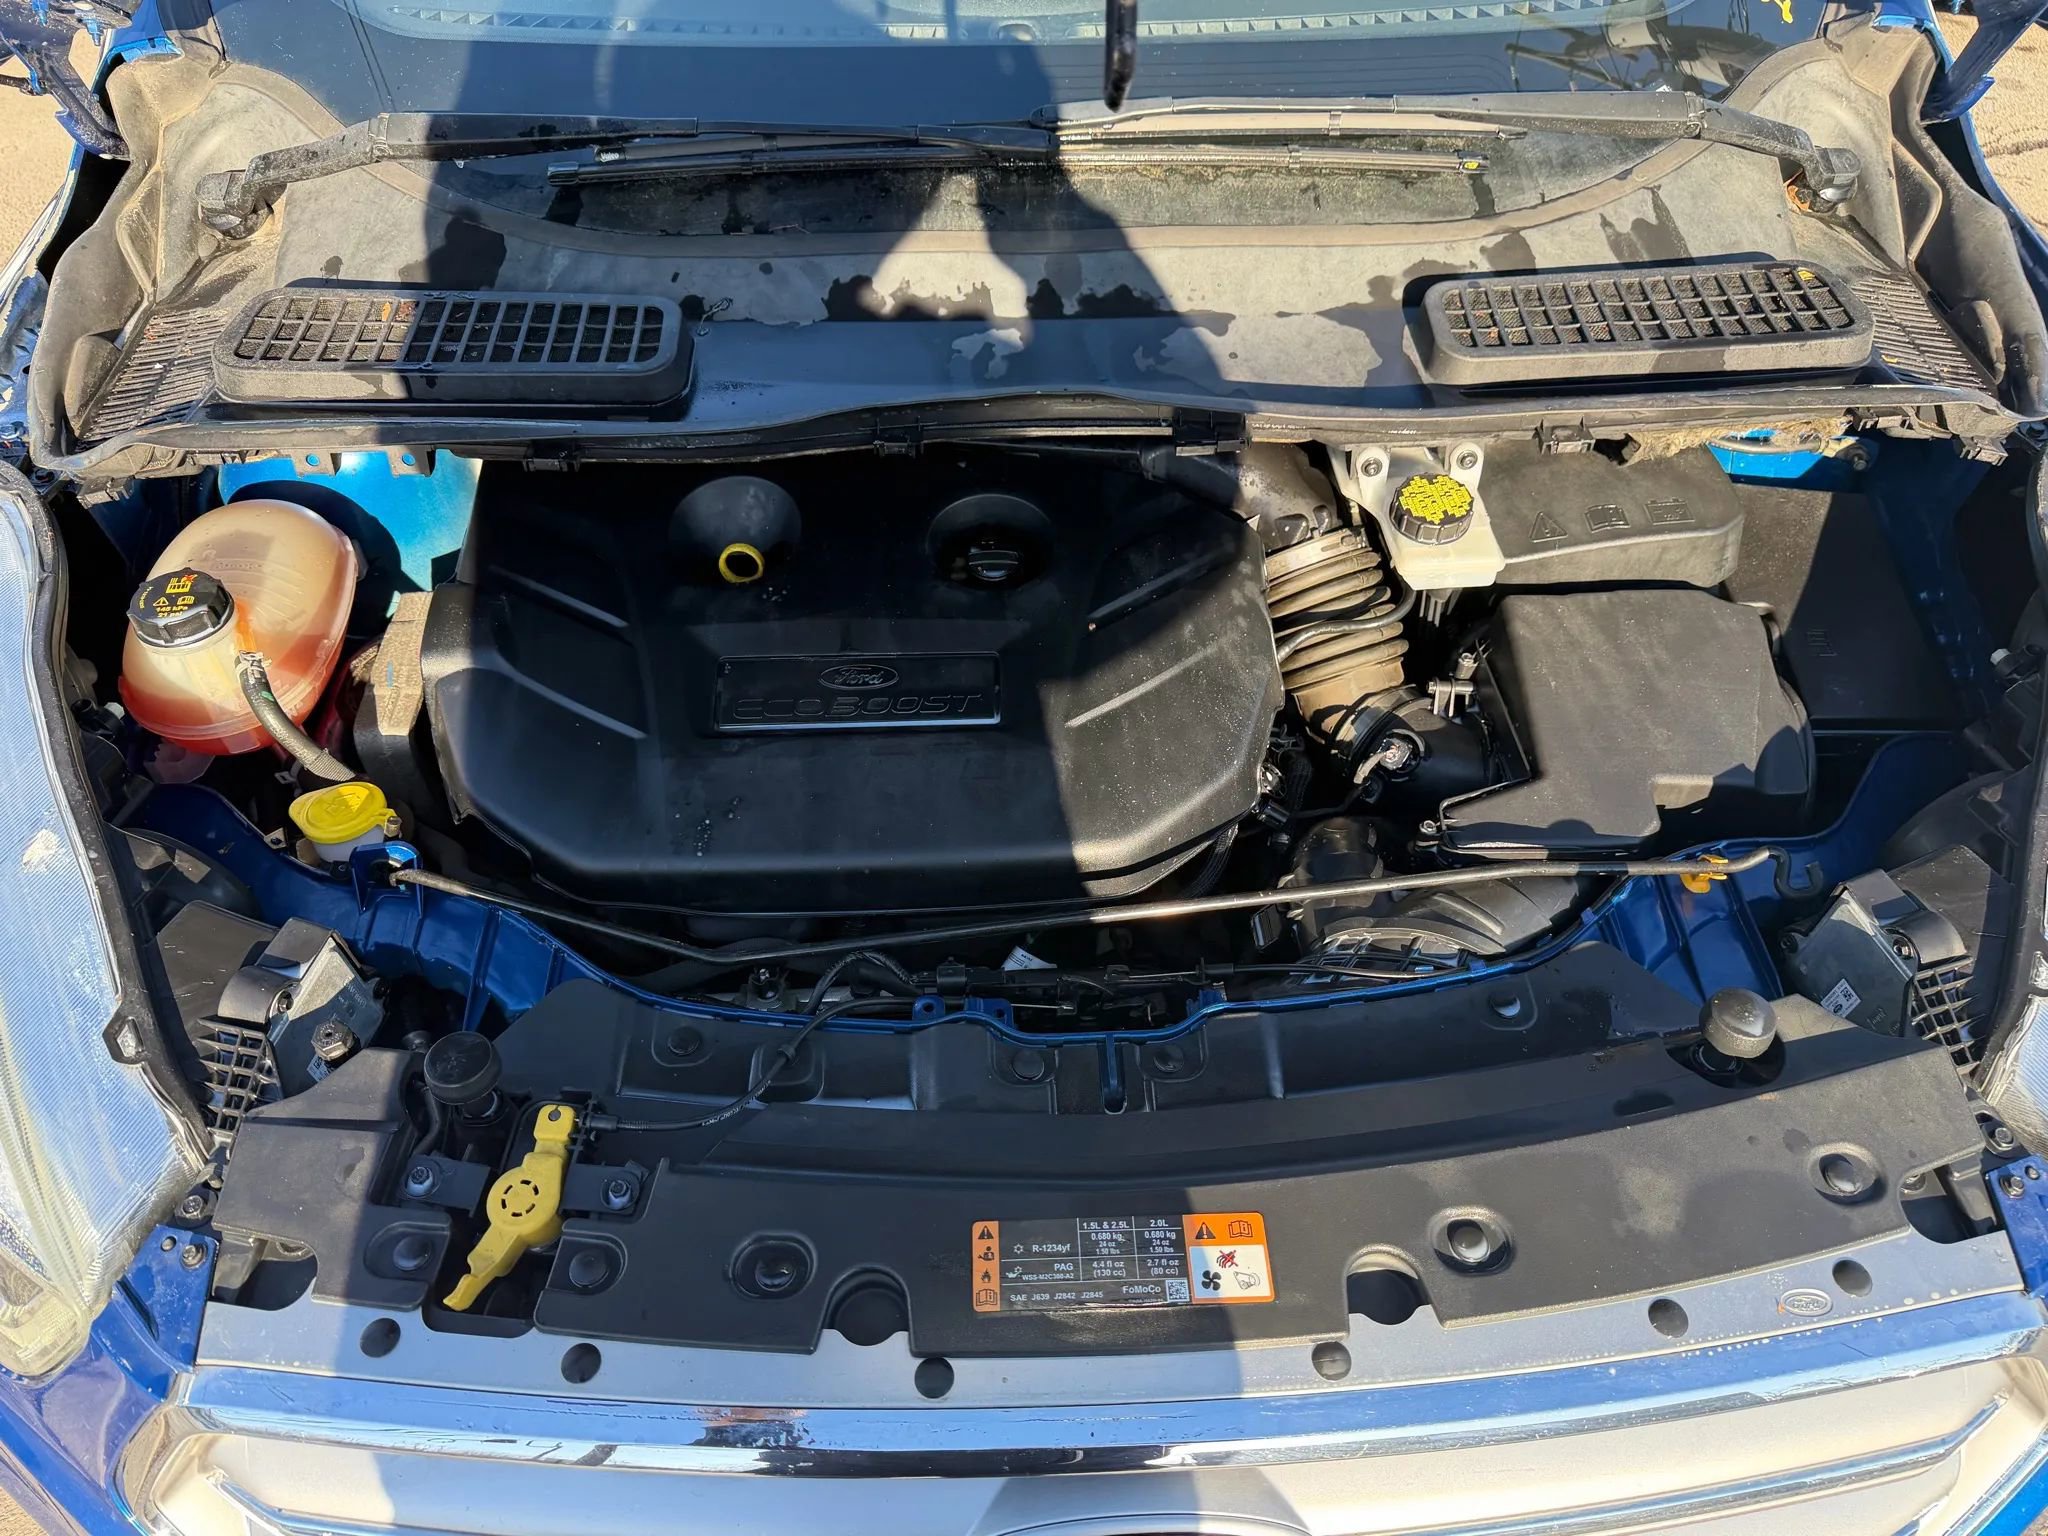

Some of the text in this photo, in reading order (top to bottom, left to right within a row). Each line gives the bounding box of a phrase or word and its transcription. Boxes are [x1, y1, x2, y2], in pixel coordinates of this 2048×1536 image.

[733, 694, 982, 720] ECOBOOST
[1082, 1220, 1130, 1230] 1.5L & 2.5L
[1150, 1219, 1169, 1227] 2.0L
[1091, 1232, 1123, 1241] 0.680 kg
[1144, 1230, 1176, 1239] 0.680 kg
[1032, 1243, 1071, 1253] R-1234yf
[1054, 1262, 1074, 1271] PAG
[1161, 1258, 1167, 1266] fl
[1093, 1269, 1126, 1278] (130 cc)
[1150, 1267, 1179, 1276] (80 cc)
[1122, 1284, 1161, 1294] FoMoCo
[1010, 1291, 1104, 1302] SAE J639 J2842 J2845
